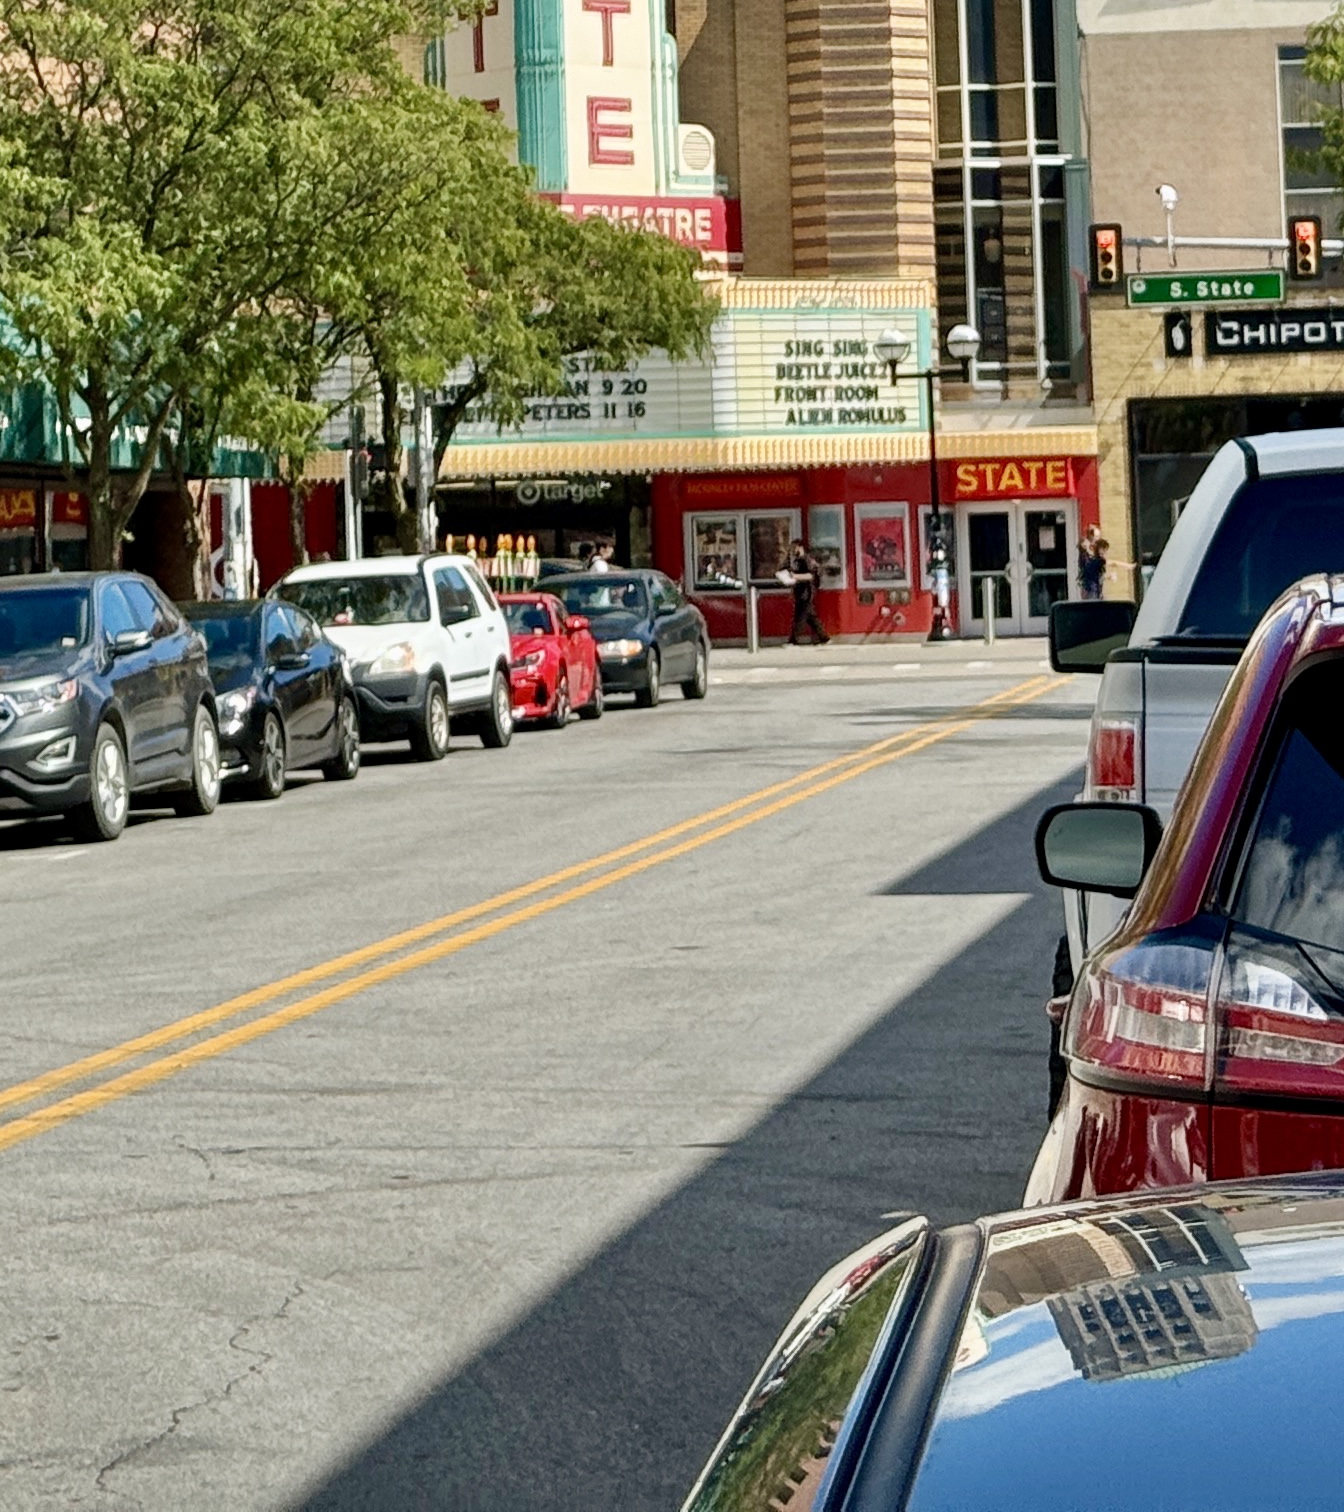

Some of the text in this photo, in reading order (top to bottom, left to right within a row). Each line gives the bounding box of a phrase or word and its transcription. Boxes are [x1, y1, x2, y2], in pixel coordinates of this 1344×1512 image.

[582, 204, 712, 241] HEATRE
[1169, 279, 1255, 298] S. State
[783, 338, 869, 357] SING SING
[602, 379, 614, 396] 9
[620, 378, 648, 396] 20
[834, 384, 879, 402] ROOM
[628, 400, 647, 419] 16
[838, 406, 907, 425] ROMULUS
[956, 460, 1066, 492] STATE
[543, 481, 606, 503] target
